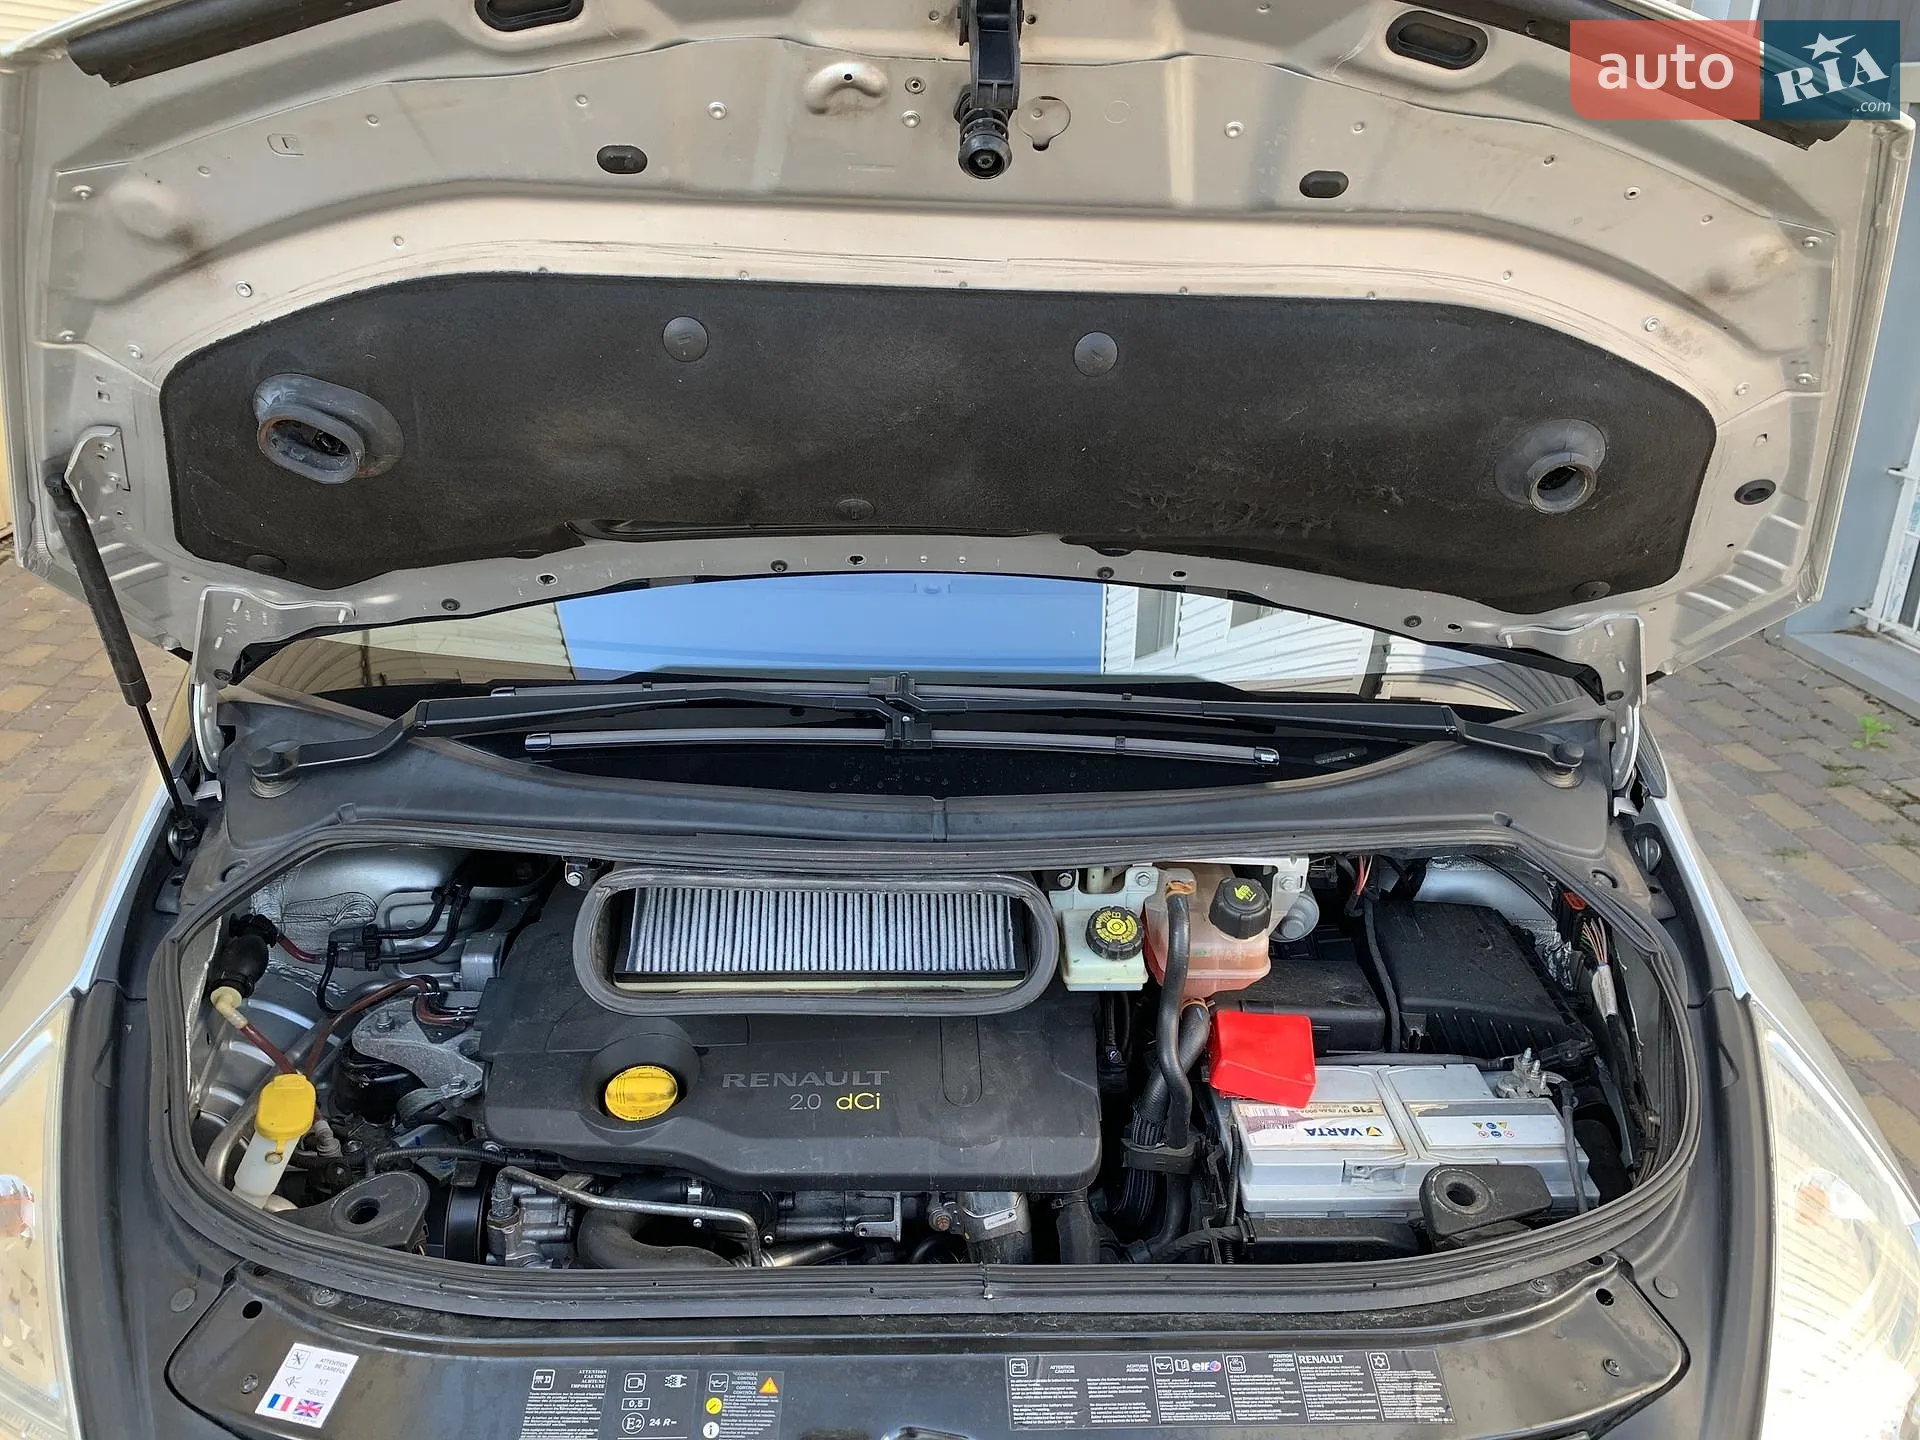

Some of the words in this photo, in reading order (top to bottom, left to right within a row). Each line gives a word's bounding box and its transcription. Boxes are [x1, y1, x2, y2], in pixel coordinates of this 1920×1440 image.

[722, 1070, 889, 1088] RENAULT
[789, 1094, 821, 1111] 2.0
[836, 1092, 880, 1110] dCi
[1352, 1105, 1374, 1113] F19
[1304, 1127, 1363, 1137] VARTA
[320, 1358, 348, 1368] ATTENTION
[1298, 1355, 1344, 1364] RENAULT
[629, 1399, 643, 1409] 0,5
[625, 1417, 642, 1430] E2
[649, 1418, 661, 1426] 24
